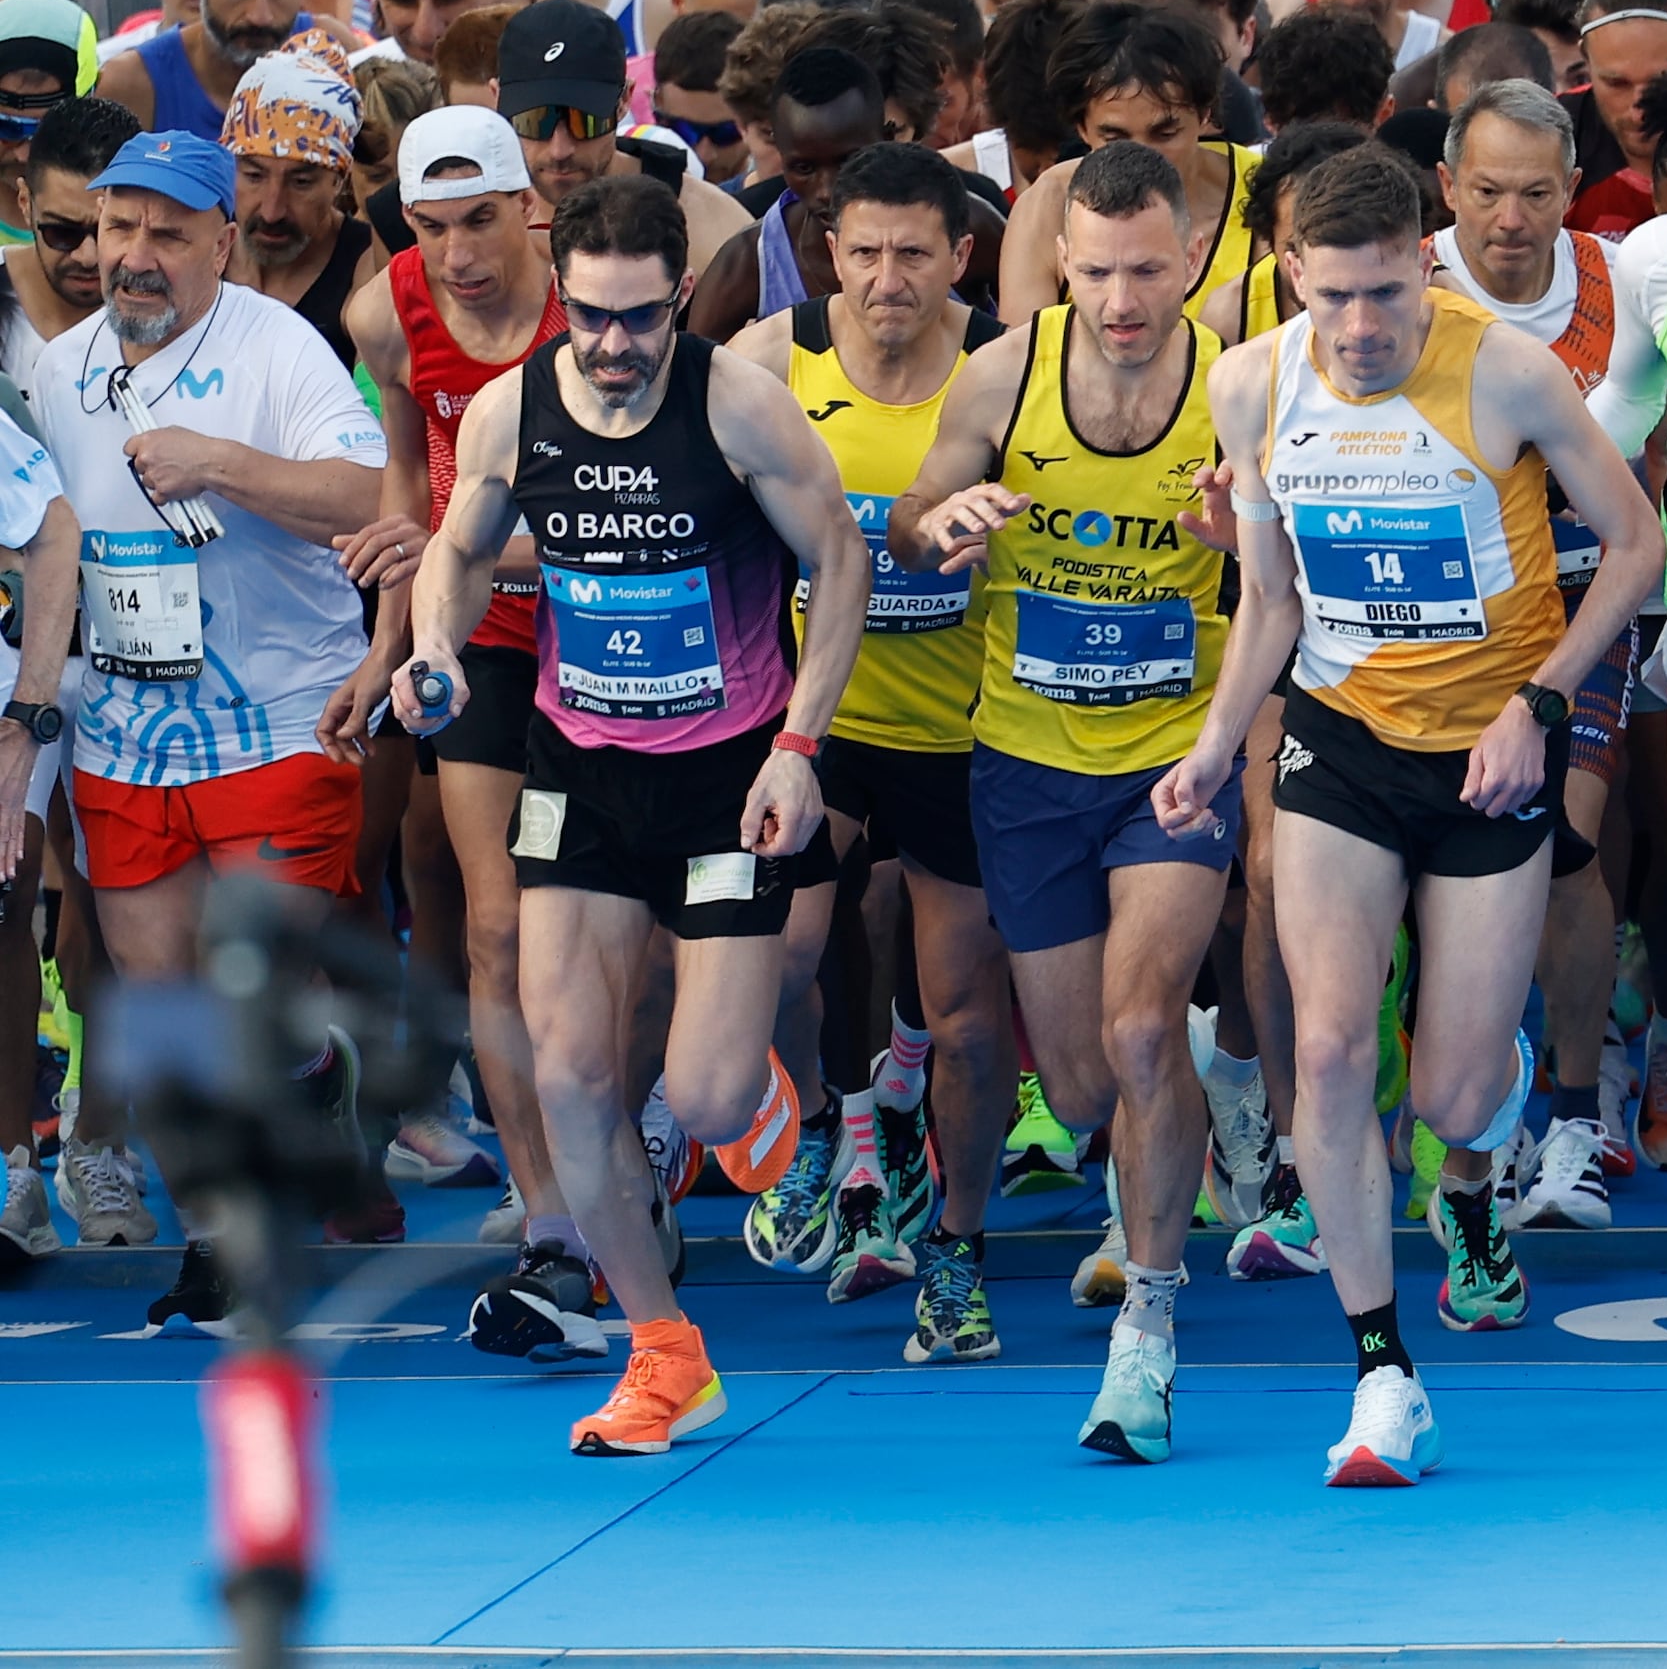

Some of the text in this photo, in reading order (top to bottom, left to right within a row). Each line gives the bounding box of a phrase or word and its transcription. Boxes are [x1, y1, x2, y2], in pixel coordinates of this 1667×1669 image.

[1330, 430, 1408, 443] PAMPLONA
[1336, 442, 1402, 456] ATLÉTICO
[574, 464, 660, 492] CUPA
[1277, 470, 1439, 496] grupompleo
[577, 513, 695, 539] BARCO
[1370, 517, 1431, 531] Movistar
[109, 542, 164, 558] Movistar
[1052, 557, 1148, 582] PODISTICA
[1364, 552, 1404, 584] 14
[1015, 562, 1081, 595] VALLE
[610, 586, 673, 600] Movistar
[867, 598, 946, 612] GUARDA
[1365, 603, 1422, 622] DIEGO
[916, 617, 958, 629] MADRID
[1333, 622, 1374, 637] Joma
[1085, 623, 1122, 645] 39
[1431, 627, 1475, 638] MADRID
[606, 630, 643, 655] 42
[156, 665, 197, 677] MADRID
[1056, 664, 1151, 683] SIMO PEY
[579, 674, 698, 695] JUAN M MAILLO
[1139, 683, 1183, 698] MADRID
[576, 695, 612, 714] Joma
[671, 697, 716, 714] MADRID
